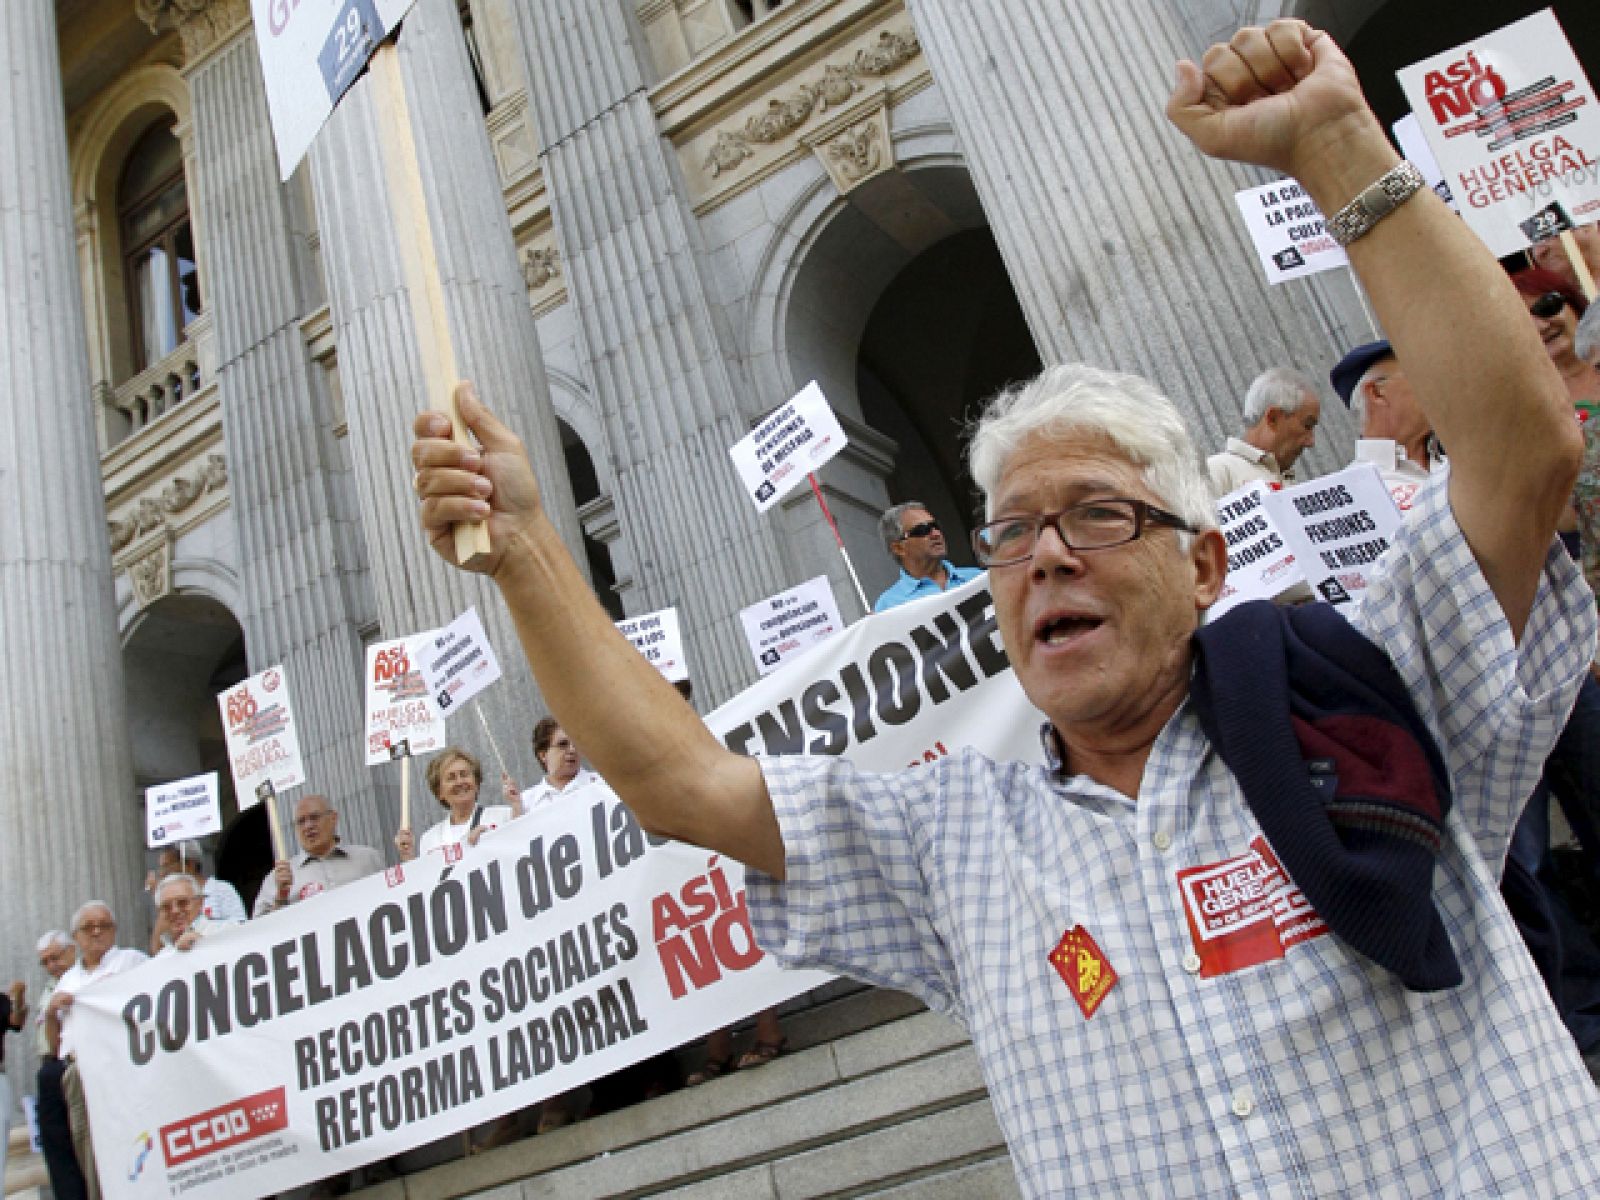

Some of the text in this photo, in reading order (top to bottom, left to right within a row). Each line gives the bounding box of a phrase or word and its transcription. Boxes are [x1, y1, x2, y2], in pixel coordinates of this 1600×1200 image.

[335, 7, 361, 61] 29
[1428, 73, 1507, 125] NO
[1458, 135, 1574, 191] HUELGA
[1468, 148, 1597, 208] GENERAL
[1260, 191, 1280, 208] LA
[1265, 209, 1286, 227] LA
[1304, 509, 1376, 545] PENSIONES
[1319, 549, 1341, 571] DE
[1334, 536, 1391, 568] MISERIA
[374, 656, 411, 683] NO
[228, 698, 258, 728] NO
[121, 858, 508, 1066] CONGELACIÓN
[516, 833, 582, 919] de
[656, 907, 765, 1000] NO
[294, 901, 639, 1091] RECORTES SOCIALES
[315, 977, 648, 1152] REFORMA LABORAL
[166, 1107, 250, 1159] CCOO
